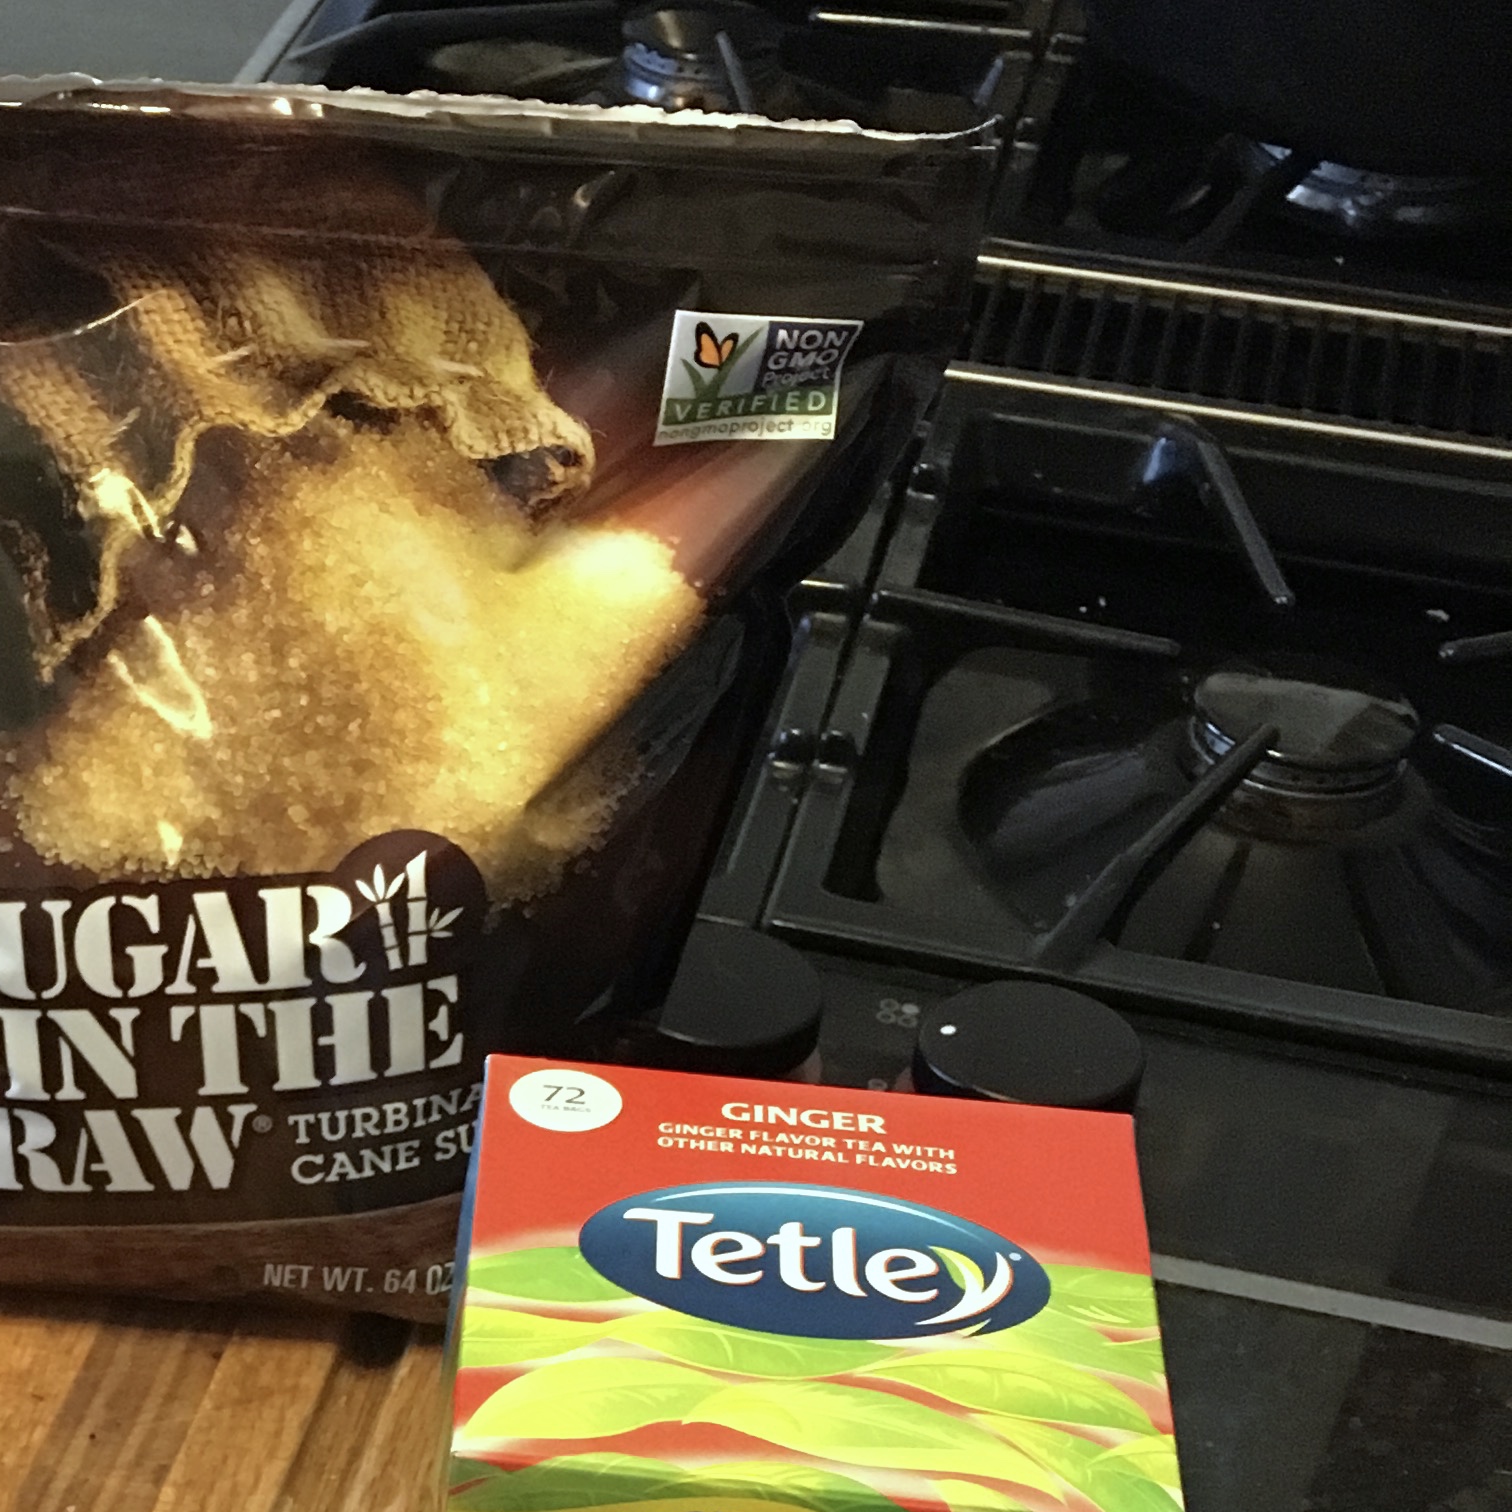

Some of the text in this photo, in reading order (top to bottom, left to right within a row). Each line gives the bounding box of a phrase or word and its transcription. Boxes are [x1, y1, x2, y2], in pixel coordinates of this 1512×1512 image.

[775, 328, 849, 351] NON
[767, 349, 838, 371] GMO
[674, 390, 827, 422] VERIFIED
[657, 417, 832, 440] nongmoprojectorg
[169, 974, 464, 1098] THE
[543, 1084, 586, 1105] 72
[721, 1102, 887, 1134] GINGER
[657, 1136, 957, 1175] OTHER NATURAL FLAVORS
[658, 1122, 955, 1160] GINGER FLAVOR TEA WITH
[290, 1139, 421, 1185] CANE
[263, 1263, 314, 1289] NET
[322, 1266, 374, 1293] WT.
[383, 1268, 418, 1295] 64
[622, 1206, 1014, 1327] Tetley
